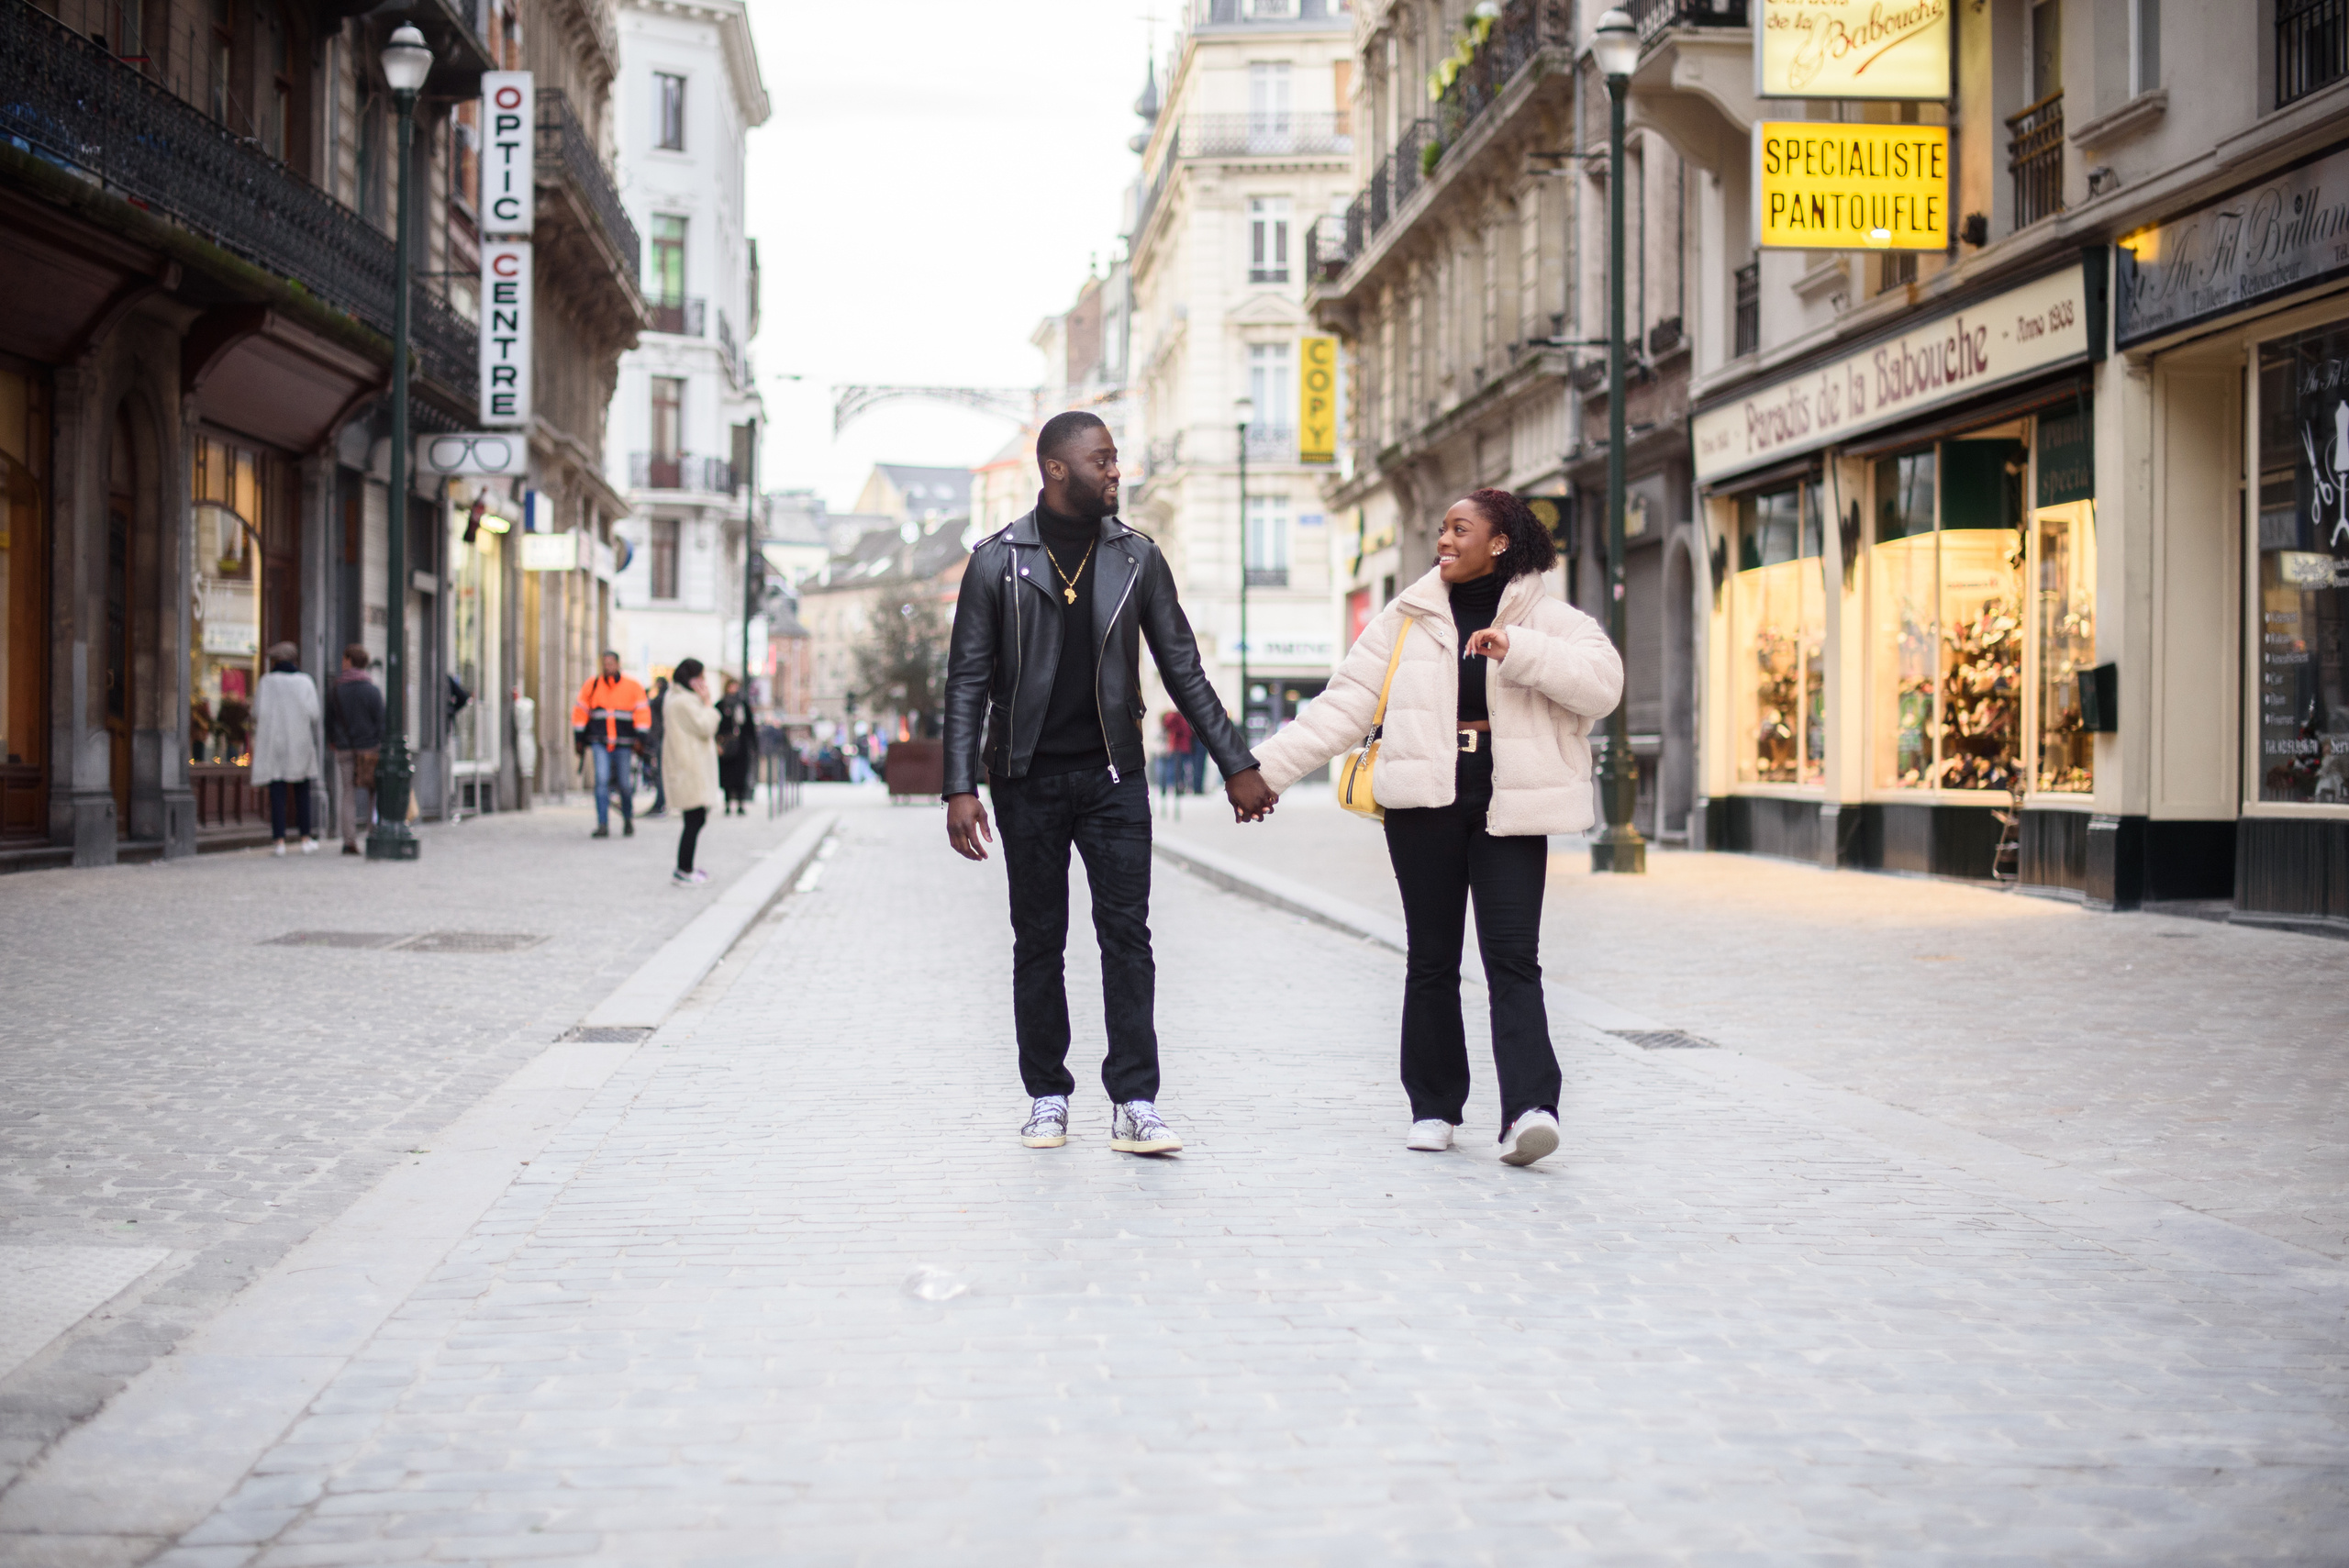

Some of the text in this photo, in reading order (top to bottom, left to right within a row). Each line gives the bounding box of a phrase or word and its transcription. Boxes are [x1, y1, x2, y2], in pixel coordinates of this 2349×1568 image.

[494, 86, 522, 221] OPTIC
[1766, 139, 1943, 179] SPECIALISTE
[1771, 193, 1940, 231] PANTOUFLE
[2199, 205, 2245, 284] Fil
[2240, 261, 2302, 298] Retoucheur
[490, 253, 519, 417] CENTRE
[1307, 339, 1330, 447] COPY
[1744, 388, 1811, 454] Paradis
[1816, 373, 1842, 429] de
[1846, 363, 1866, 417] la
[1874, 317, 1988, 408] Babouche
